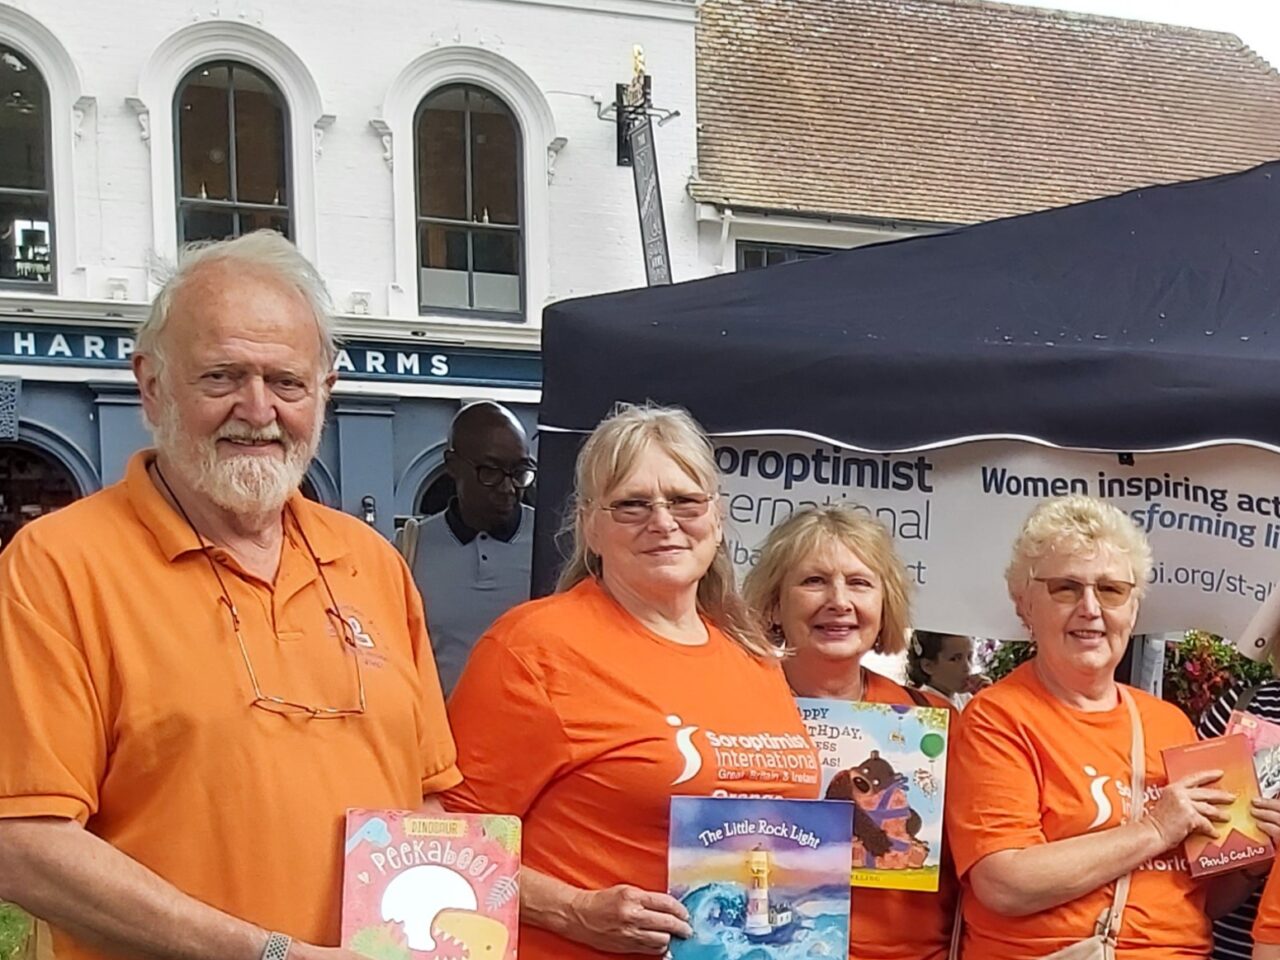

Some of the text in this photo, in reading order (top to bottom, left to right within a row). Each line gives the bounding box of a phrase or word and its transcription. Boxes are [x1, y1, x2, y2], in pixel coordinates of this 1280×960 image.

[333, 350, 449, 376] ARMS
[716, 446, 933, 493] oroptimist
[981, 466, 1088, 498] Women
[1098, 472, 1228, 512] inspiring
[1128, 503, 1256, 548] sforming
[705, 730, 810, 751] Soroptimist
[699, 819, 821, 850] The Little Rock Light
